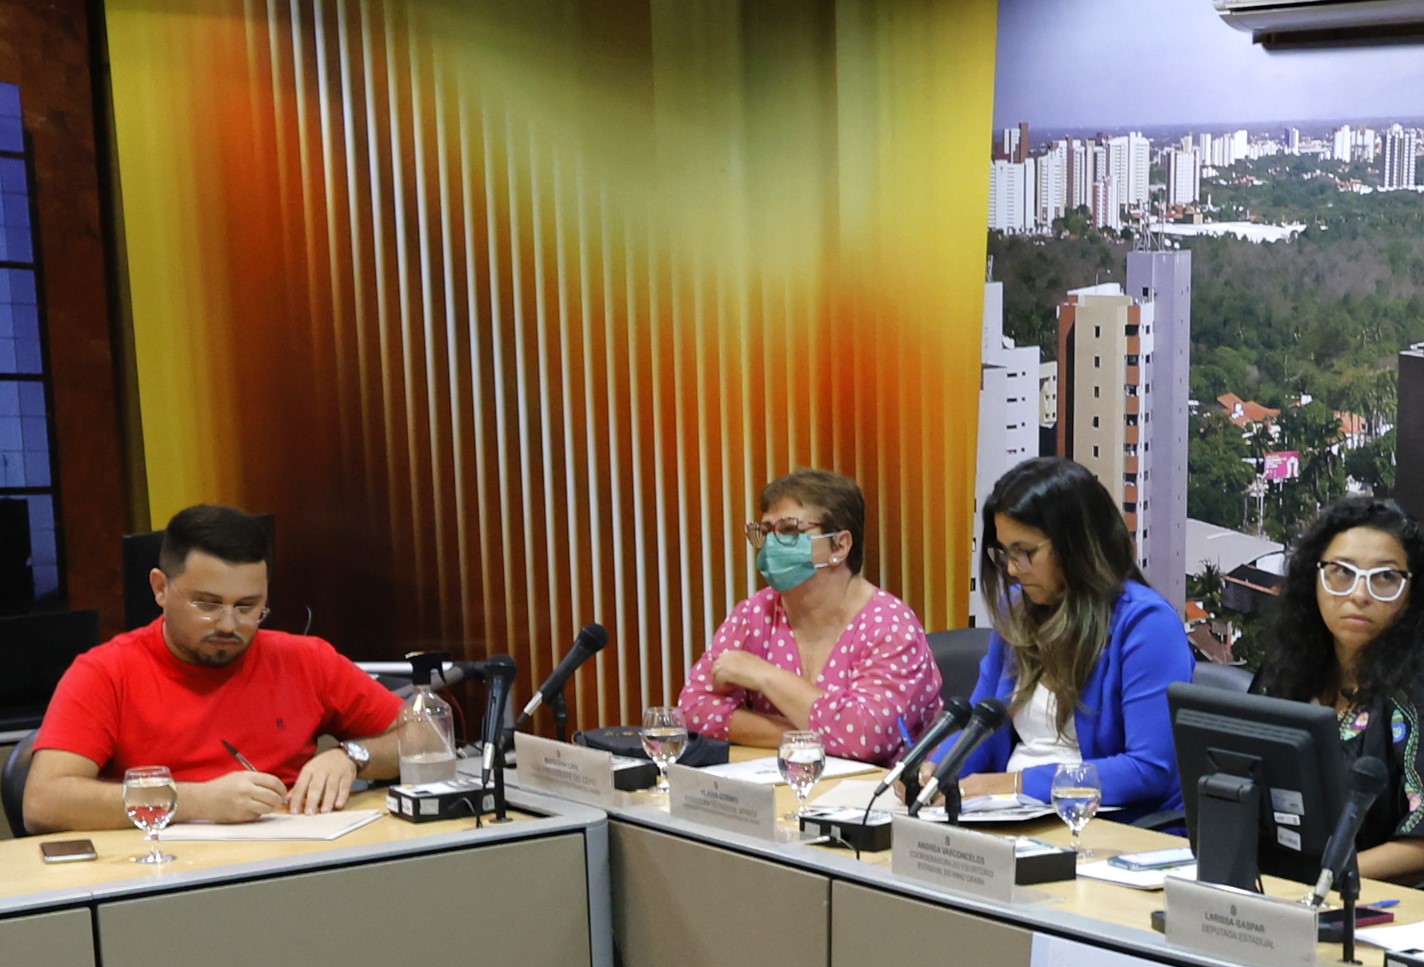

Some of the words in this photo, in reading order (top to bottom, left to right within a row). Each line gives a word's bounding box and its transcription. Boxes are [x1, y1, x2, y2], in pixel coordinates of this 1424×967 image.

[942, 847, 984, 865] VASCONCELOS
[1204, 912, 1234, 926] LARISSA
[1236, 920, 1264, 932] GASPAR
[1202, 924, 1238, 939] DEPUTADA
[1239, 932, 1274, 949] ESTADUAL
